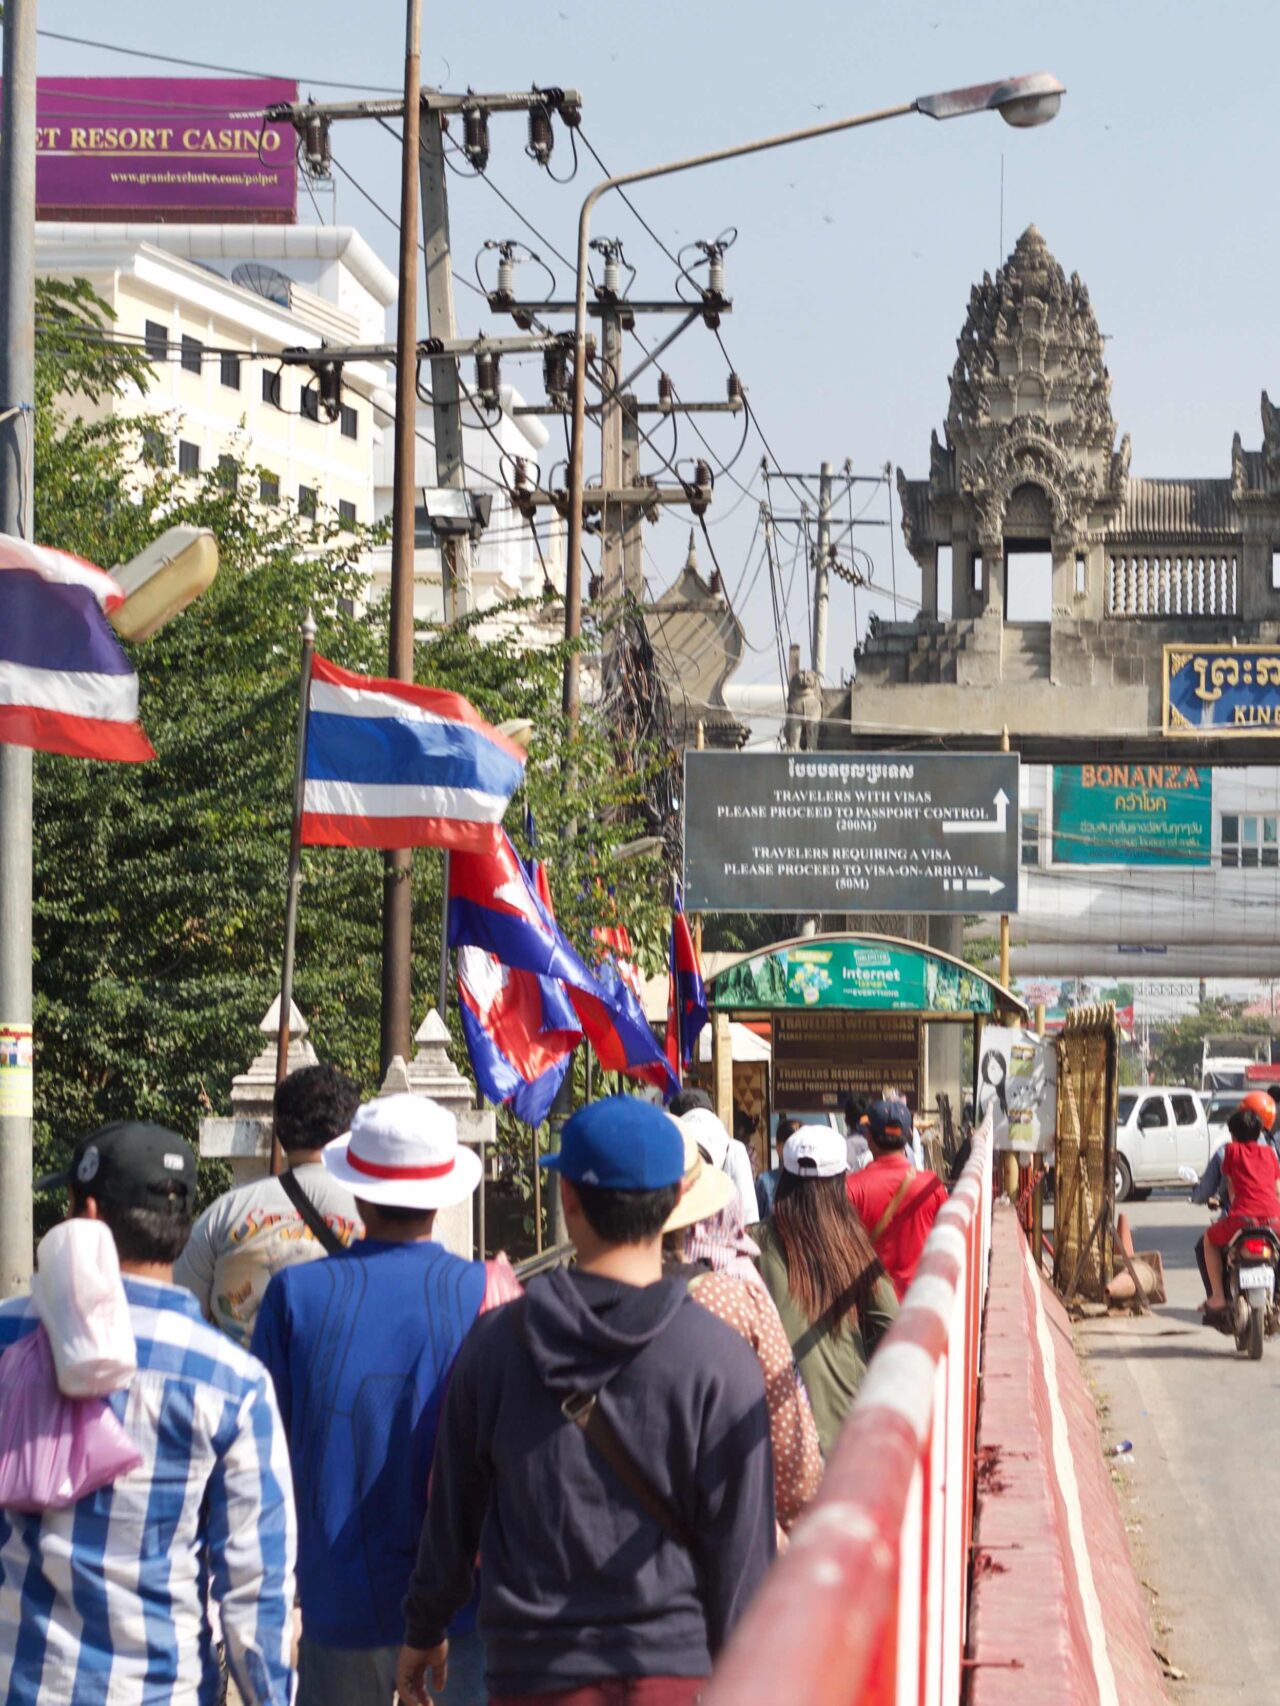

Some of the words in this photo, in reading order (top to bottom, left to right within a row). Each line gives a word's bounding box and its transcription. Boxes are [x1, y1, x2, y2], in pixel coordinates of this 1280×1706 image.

[70, 127, 173, 149] RESORT
[182, 128, 281, 151] CASINO
[1082, 764, 1199, 789] BONANZA
[774, 790, 850, 803] TRAVELERS
[855, 791, 891, 803] WITH
[894, 791, 932, 803] VISAS
[717, 806, 767, 818] PLEASE
[770, 806, 832, 819] PROCEED
[835, 807, 853, 819] TO
[856, 807, 921, 819] PASSPORT
[924, 807, 988, 820] CONTROL
[836, 819, 877, 833] (200M)
[752, 846, 829, 859] TRAVELERS
[832, 847, 907, 861] REQUIRING
[910, 848, 918, 860] A
[921, 848, 951, 860] VISA
[724, 864, 774, 876] PLEASE
[777, 864, 839, 876] PROCEED
[842, 864, 860, 876] TO
[842, 965, 900, 981] Internet
